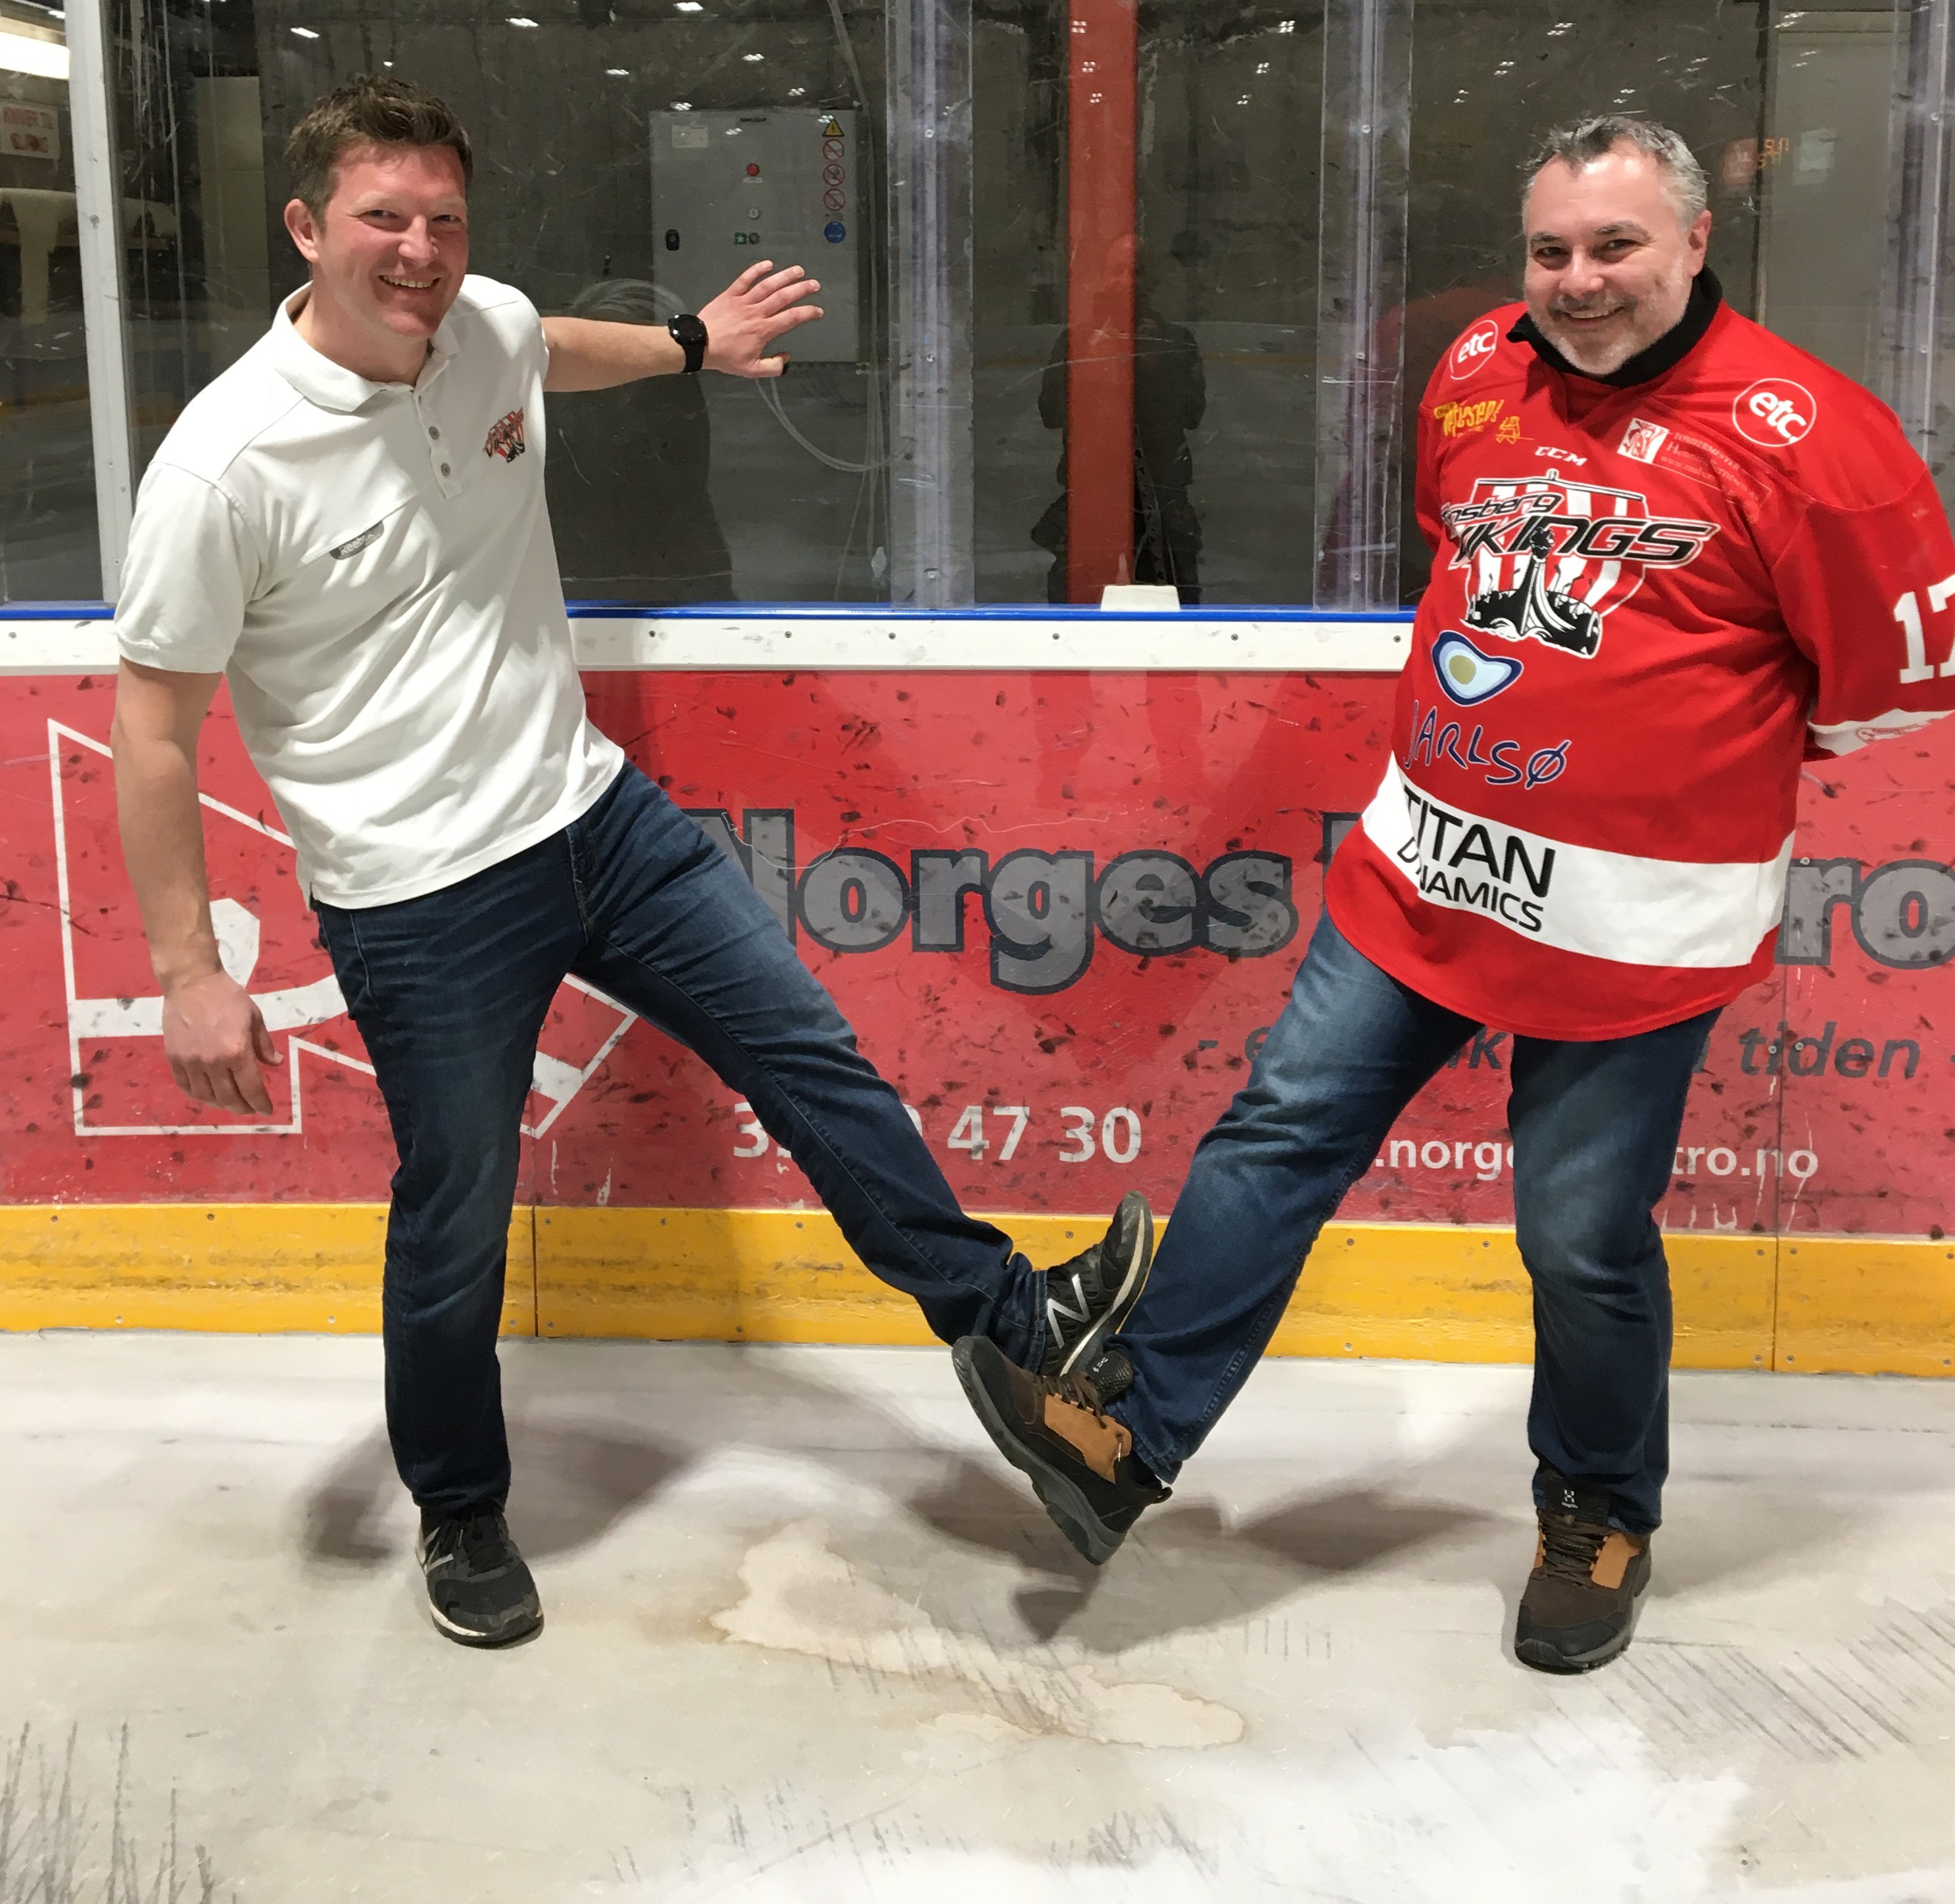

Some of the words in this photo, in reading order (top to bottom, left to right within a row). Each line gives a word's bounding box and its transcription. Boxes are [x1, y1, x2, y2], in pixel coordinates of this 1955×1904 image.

[1534, 446, 1588, 466] CCM
[1441, 492, 1563, 524] nsberg
[1403, 699, 1572, 790] JARLSØ
[1397, 836, 1545, 933] DNAMICS
[1739, 1021, 1921, 1079] tiden
[948, 1106, 1030, 1161] 47
[1059, 1106, 1142, 1163] 30
